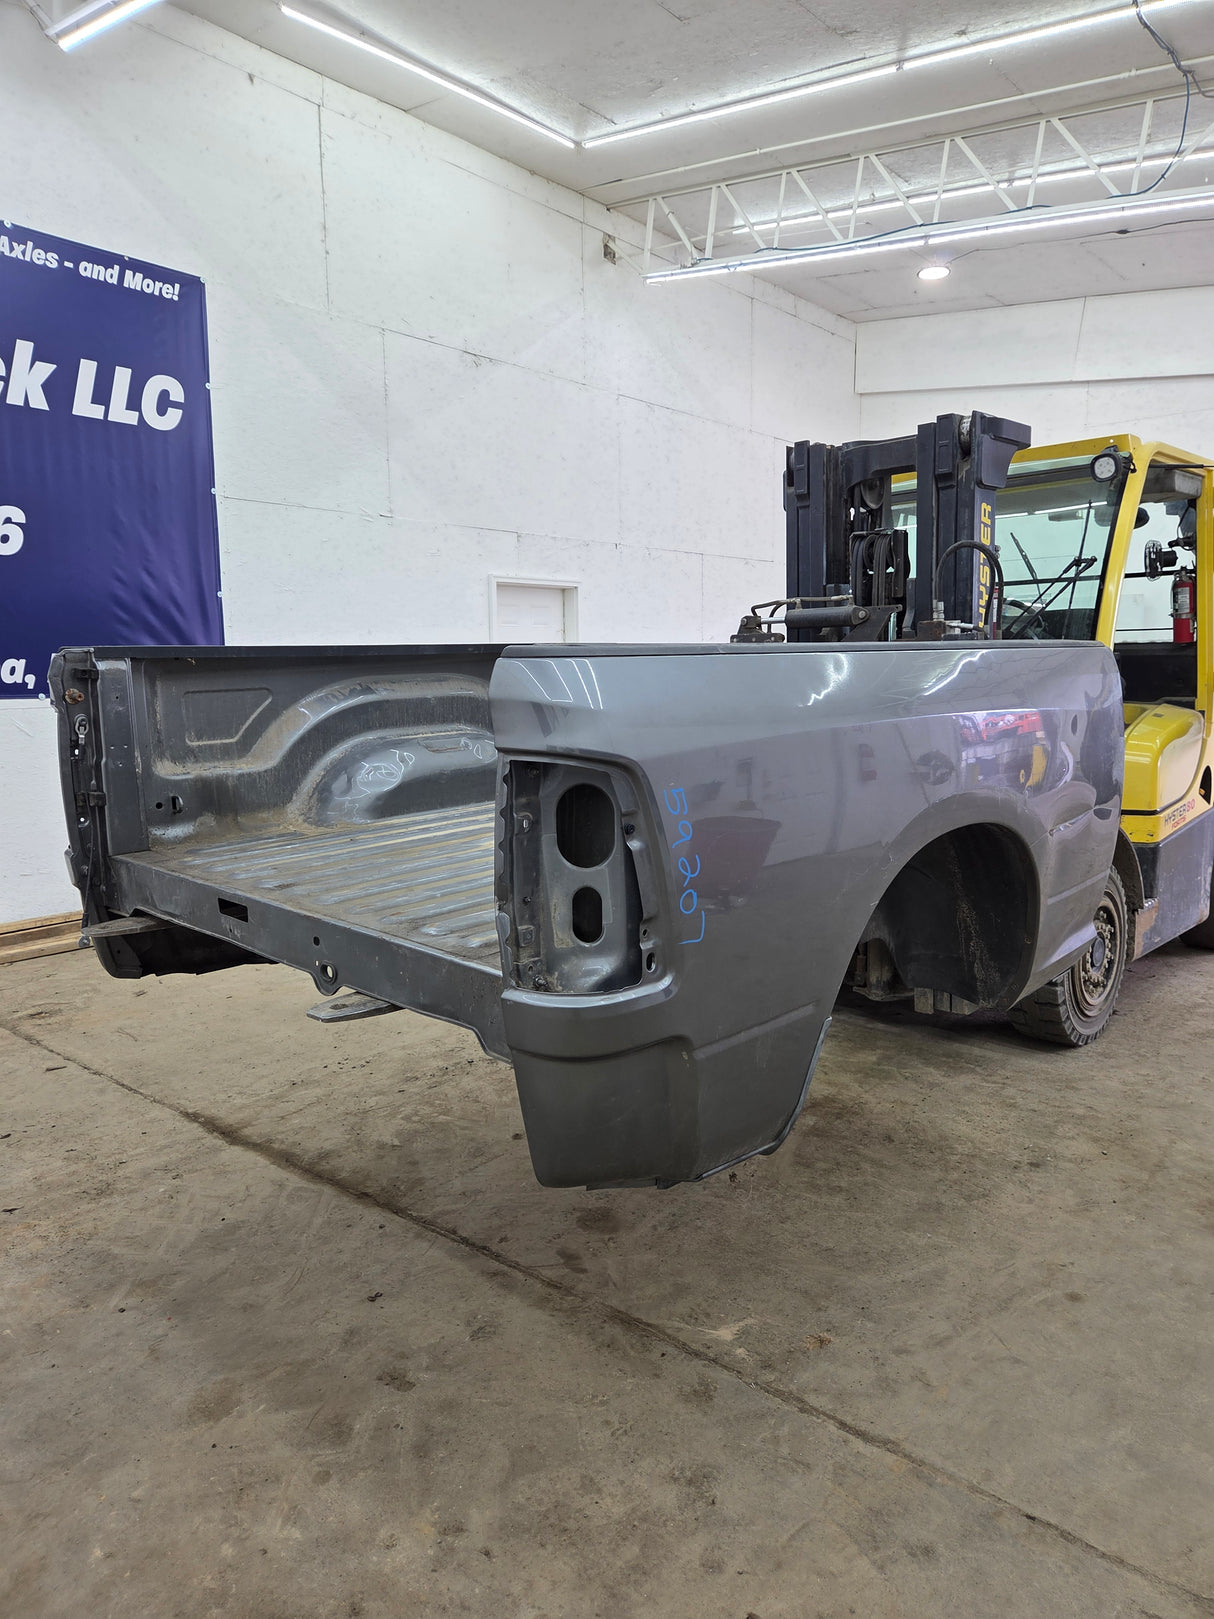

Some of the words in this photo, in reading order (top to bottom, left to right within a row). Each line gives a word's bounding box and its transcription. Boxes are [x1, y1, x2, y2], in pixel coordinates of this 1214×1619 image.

[0, 235, 59, 269] Axles
[78, 260, 120, 285] and
[123, 269, 181, 301] More!
[0, 338, 57, 411] k
[72, 358, 185, 431] LLC
[663, 787, 706, 945] 59207
